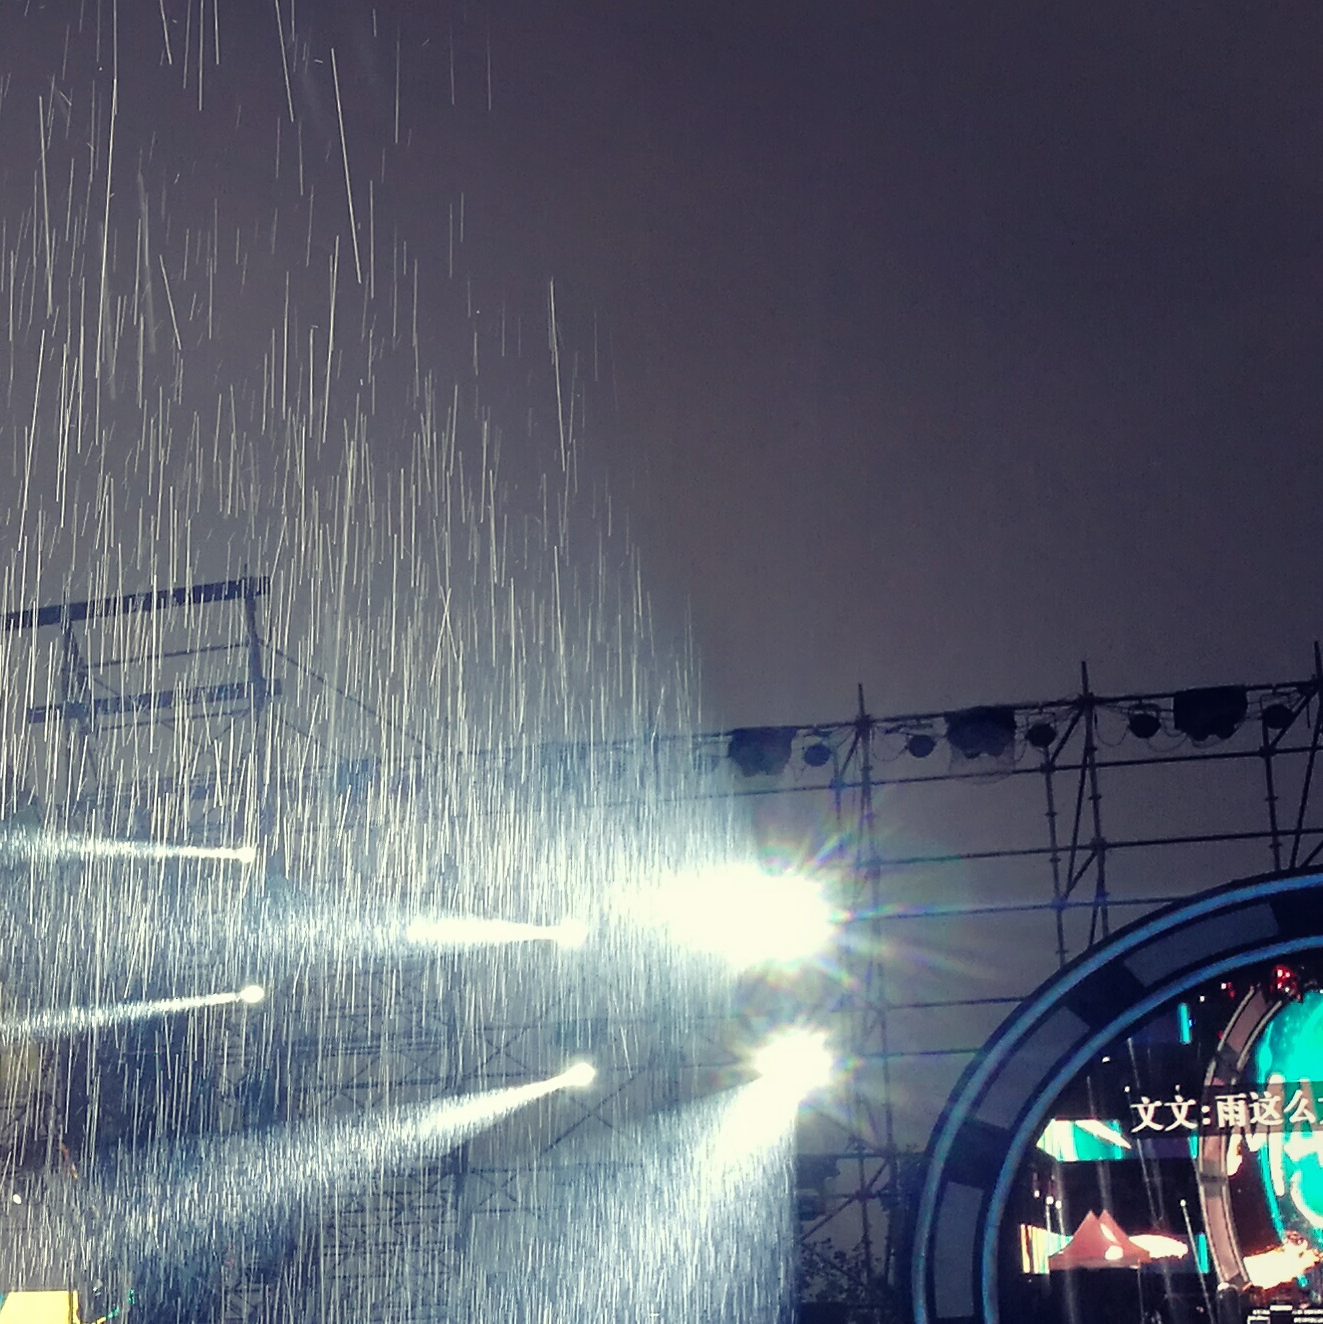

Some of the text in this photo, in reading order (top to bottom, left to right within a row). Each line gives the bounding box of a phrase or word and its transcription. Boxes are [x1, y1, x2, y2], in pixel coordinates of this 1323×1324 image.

[1130, 1089, 1323, 1133] 文文:雨这么
